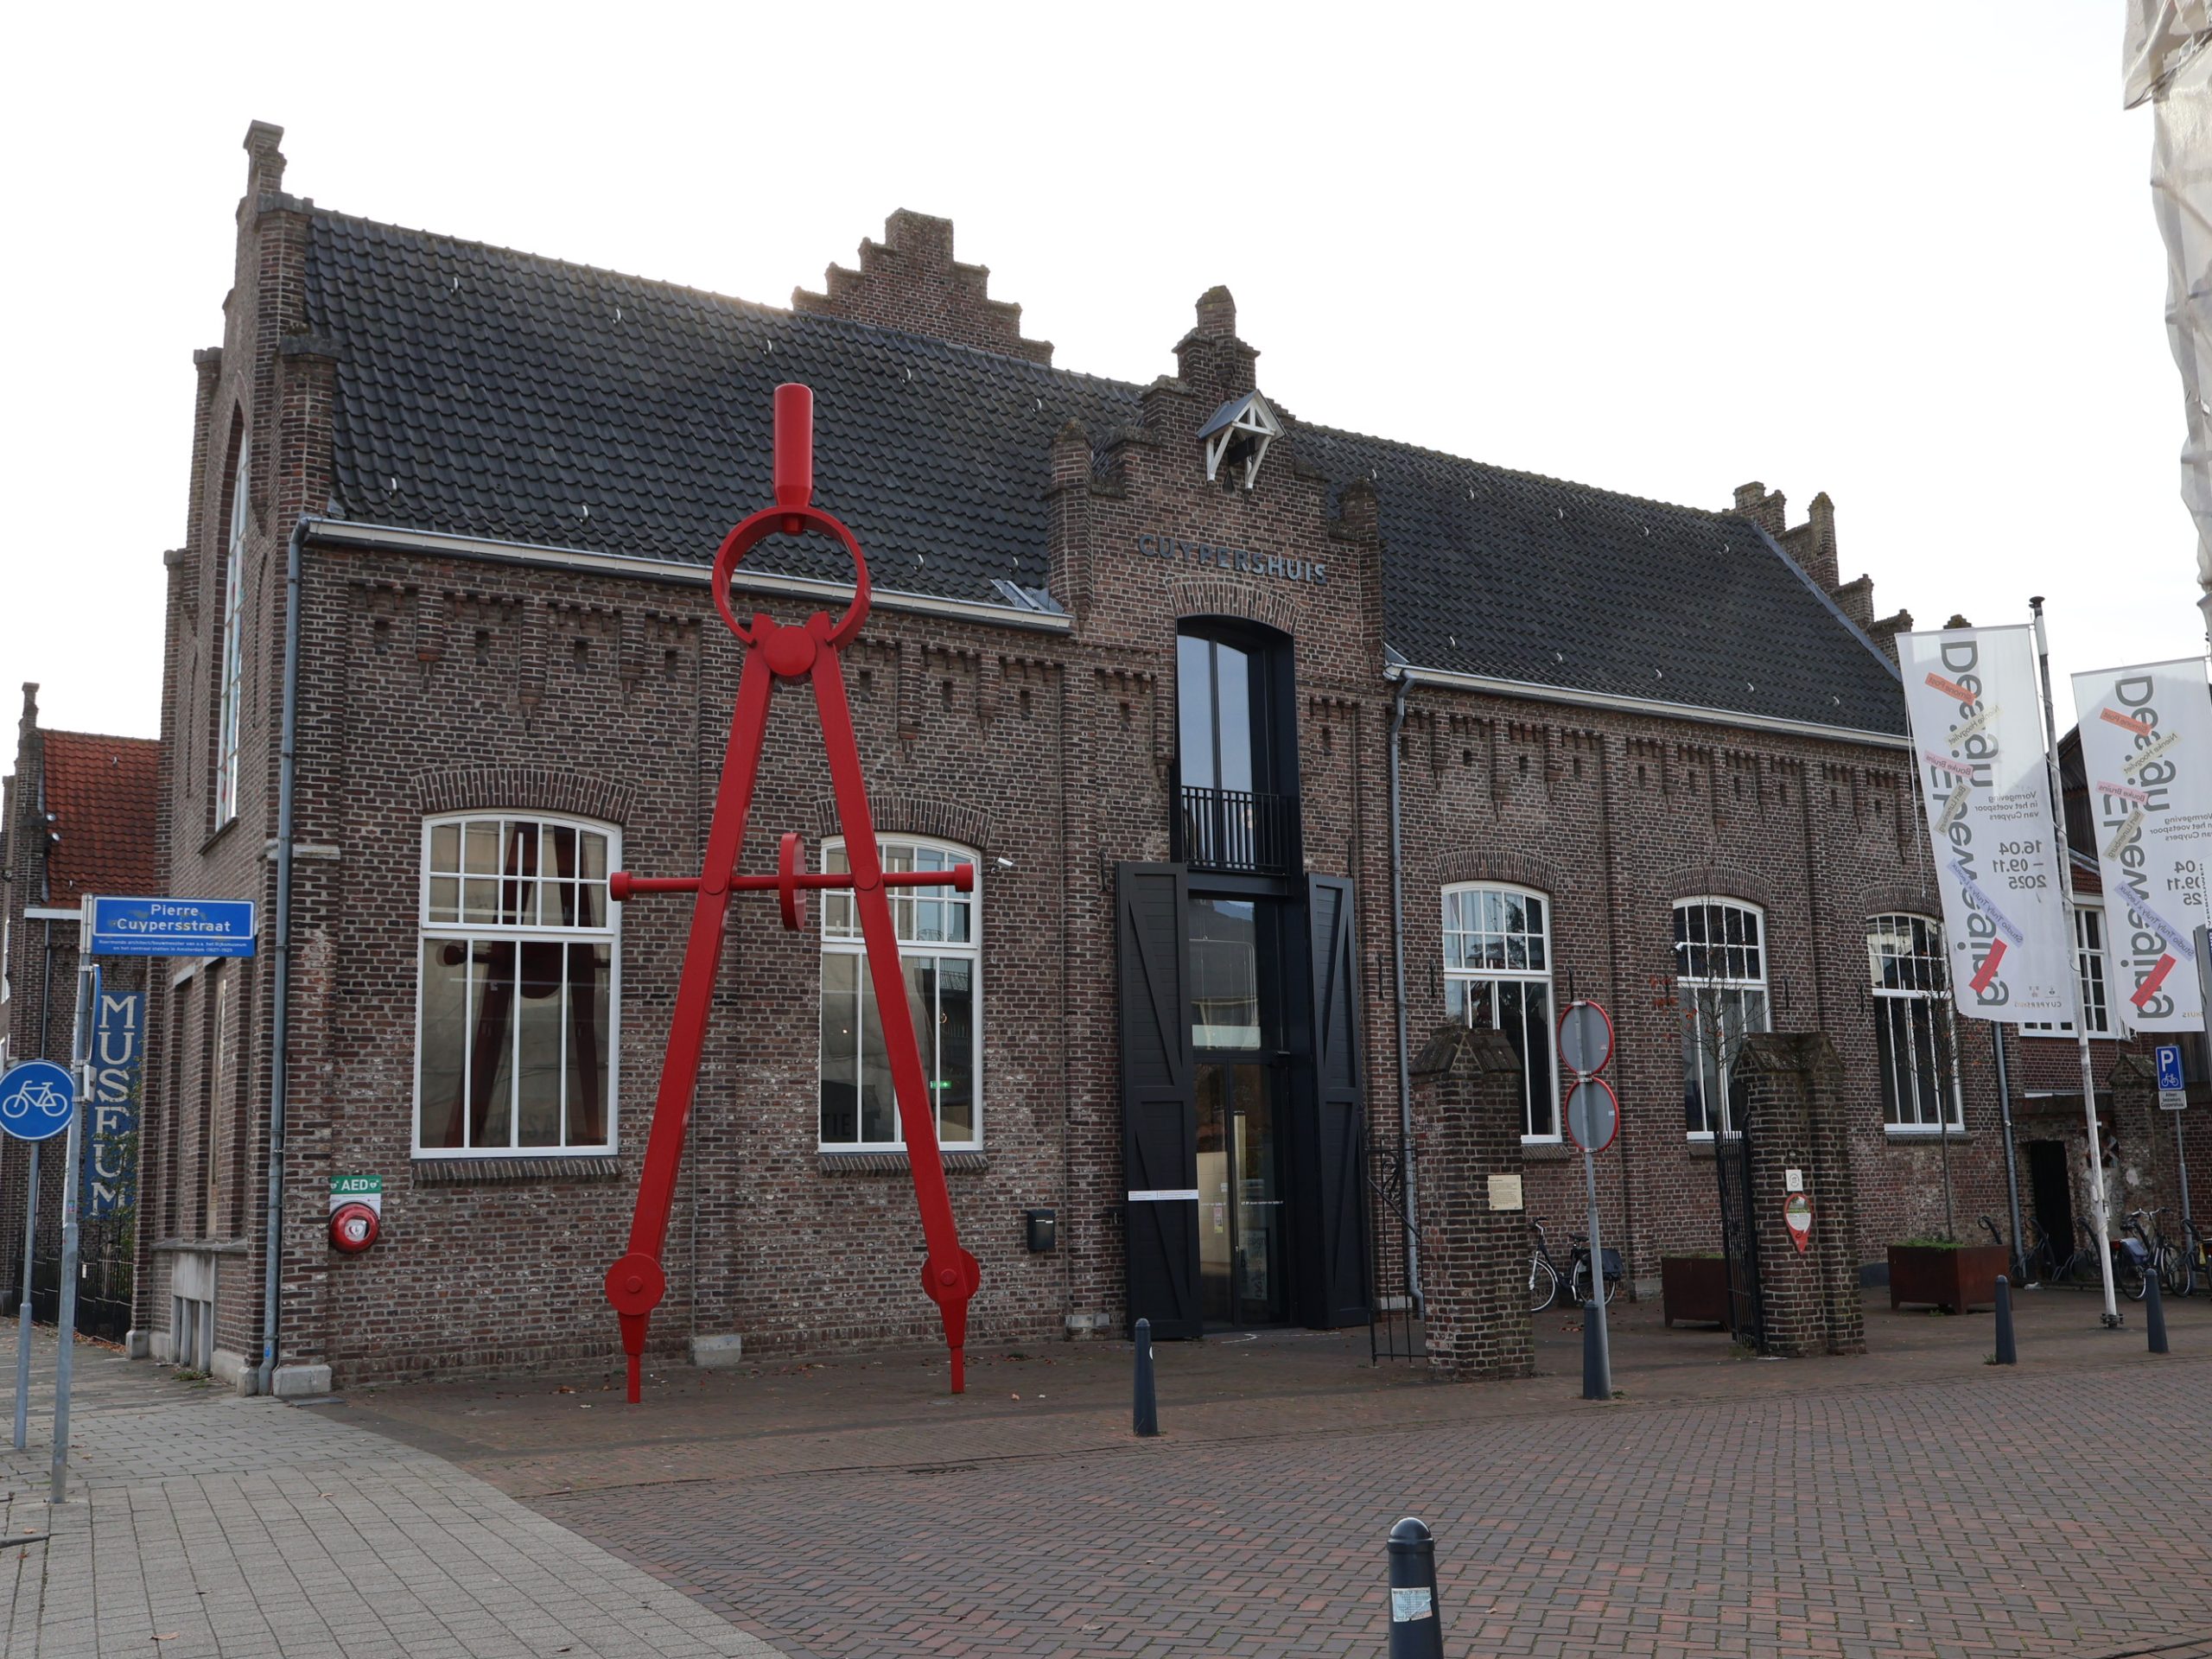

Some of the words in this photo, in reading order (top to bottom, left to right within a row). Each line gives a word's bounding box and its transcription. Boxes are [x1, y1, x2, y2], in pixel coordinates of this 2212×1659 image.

[1138, 534, 1328, 585] CUYPERSHUIS
[151, 904, 199, 917] Pierre
[117, 918, 231, 933] Cuypersstraat
[2161, 1050, 2174, 1072] P
[91, 995, 138, 1217] MUSEUM
[341, 1179, 368, 1191] AED
